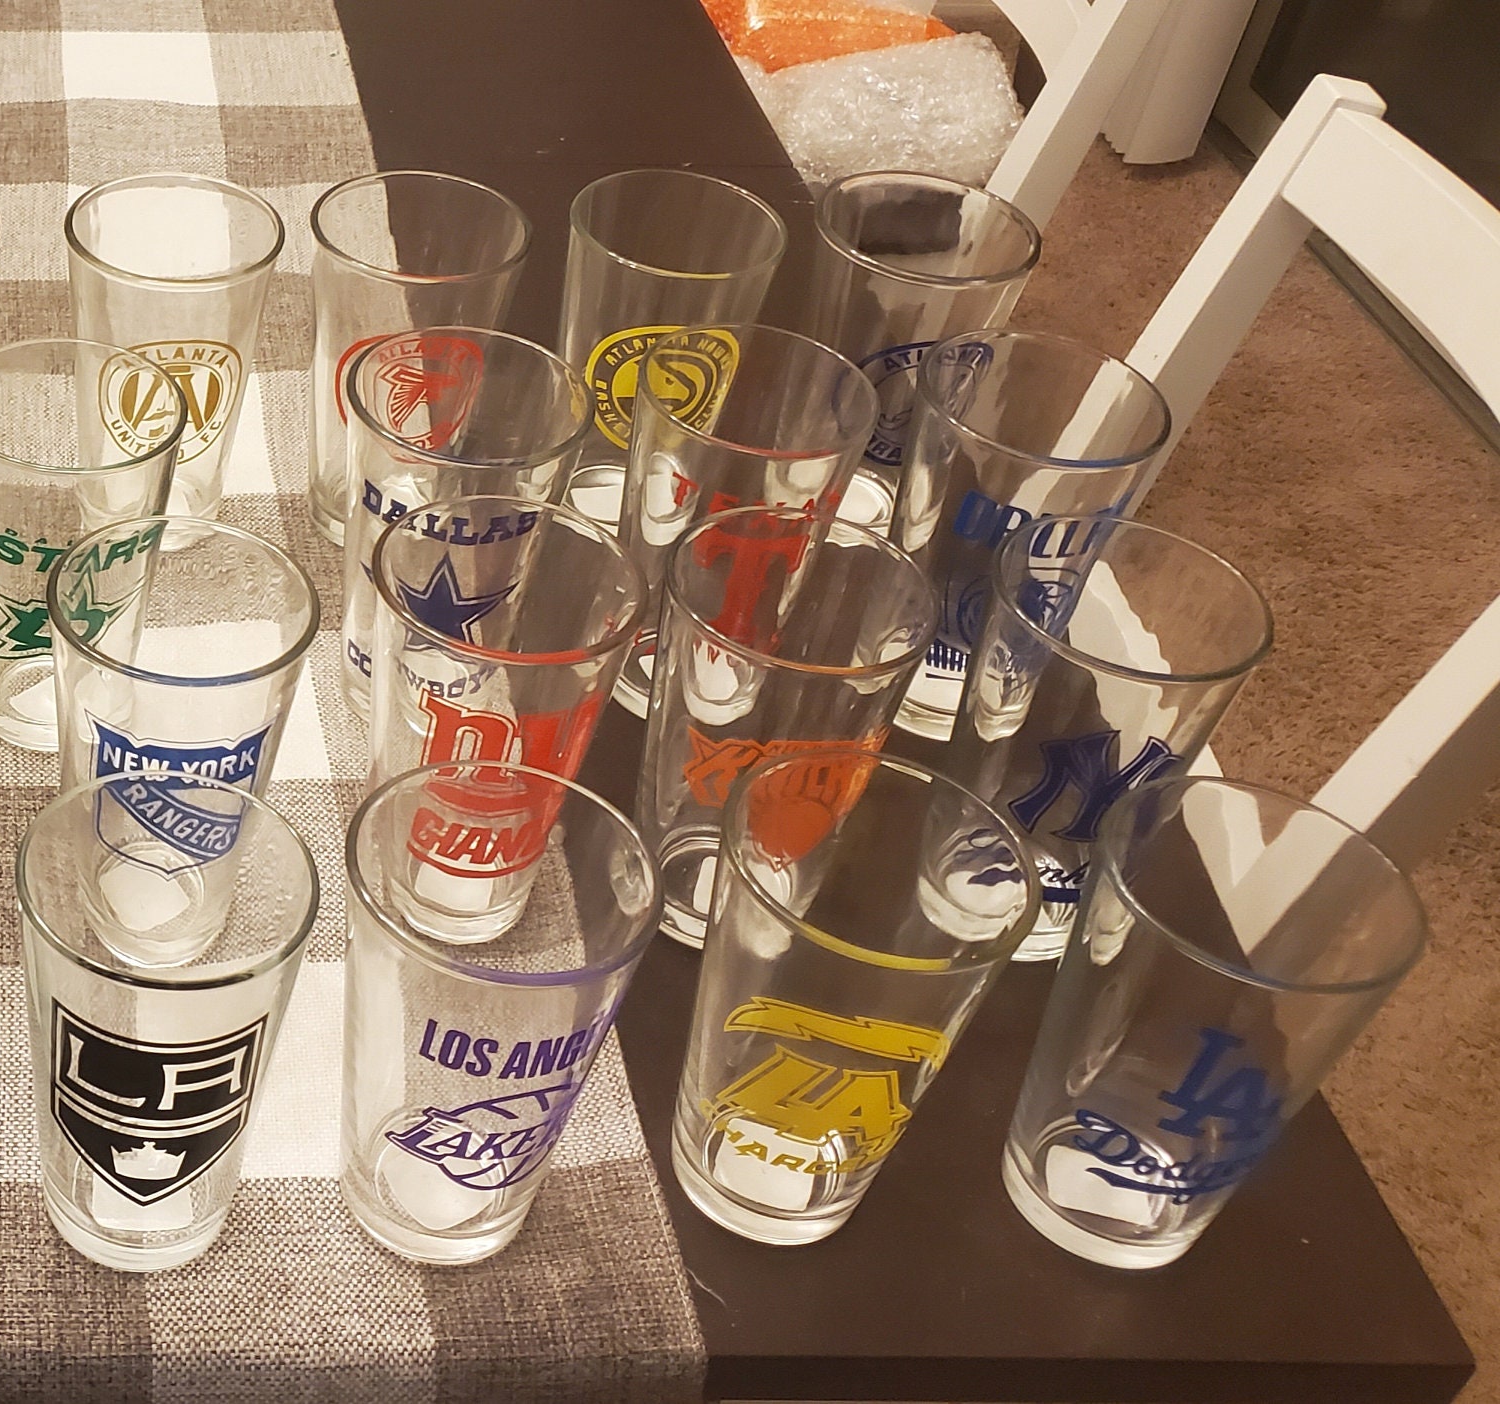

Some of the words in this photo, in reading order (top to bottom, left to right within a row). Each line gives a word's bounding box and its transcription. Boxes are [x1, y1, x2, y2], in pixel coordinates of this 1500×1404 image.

[362, 478, 538, 546] DALLAS
[103, 741, 170, 782] NEW
[181, 746, 255, 789] YORK
[122, 783, 237, 851] RANGERS
[66, 1032, 249, 1110] LA
[418, 1018, 499, 1077] LOS
